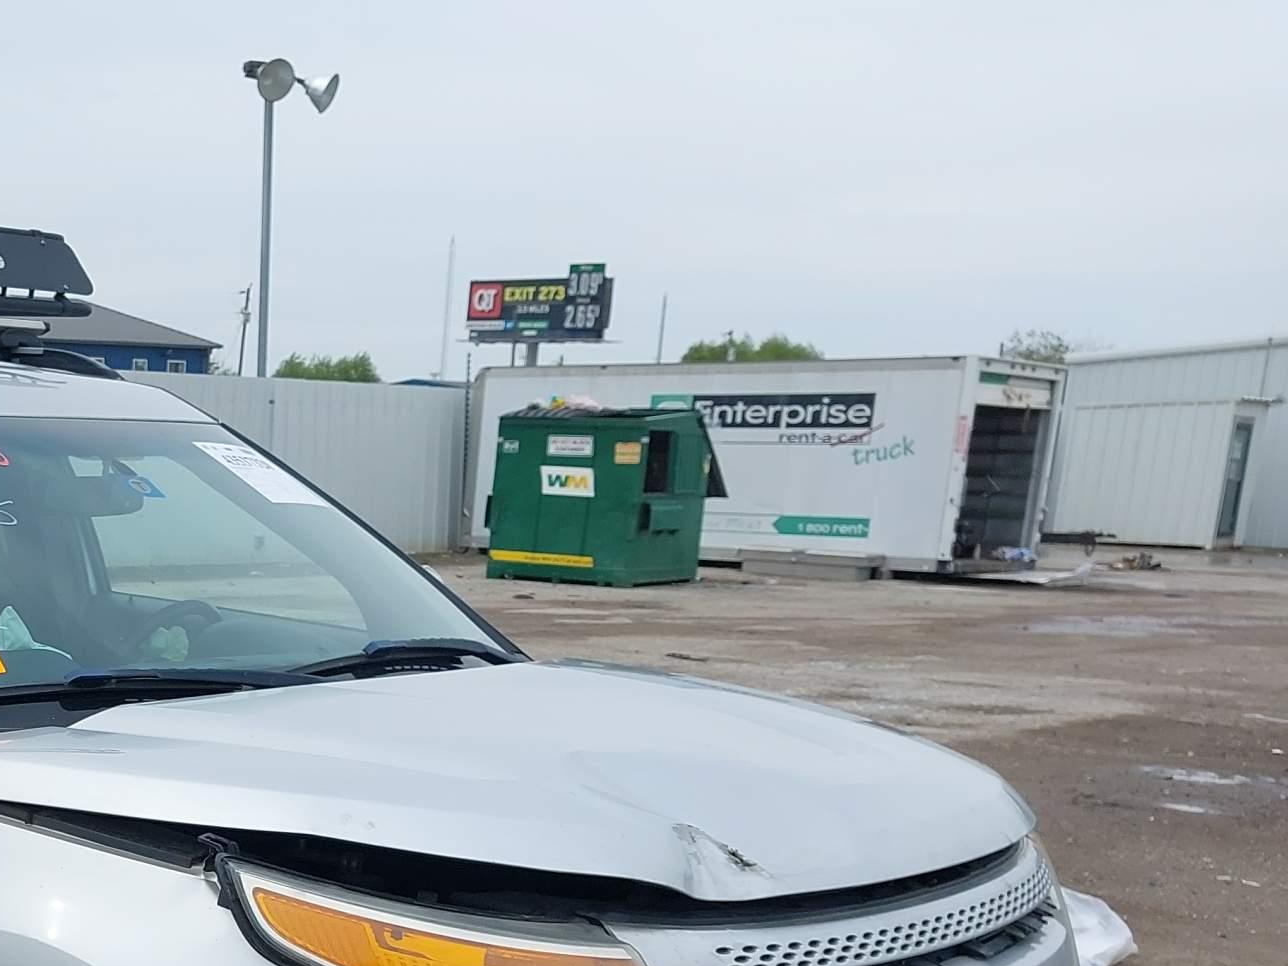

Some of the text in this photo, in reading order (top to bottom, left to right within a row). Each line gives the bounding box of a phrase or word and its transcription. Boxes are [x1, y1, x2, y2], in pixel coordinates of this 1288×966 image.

[473, 288, 499, 312] QT
[504, 285, 566, 302] EXIT 273
[852, 436, 915, 465] truck
[548, 474, 589, 488] WM
